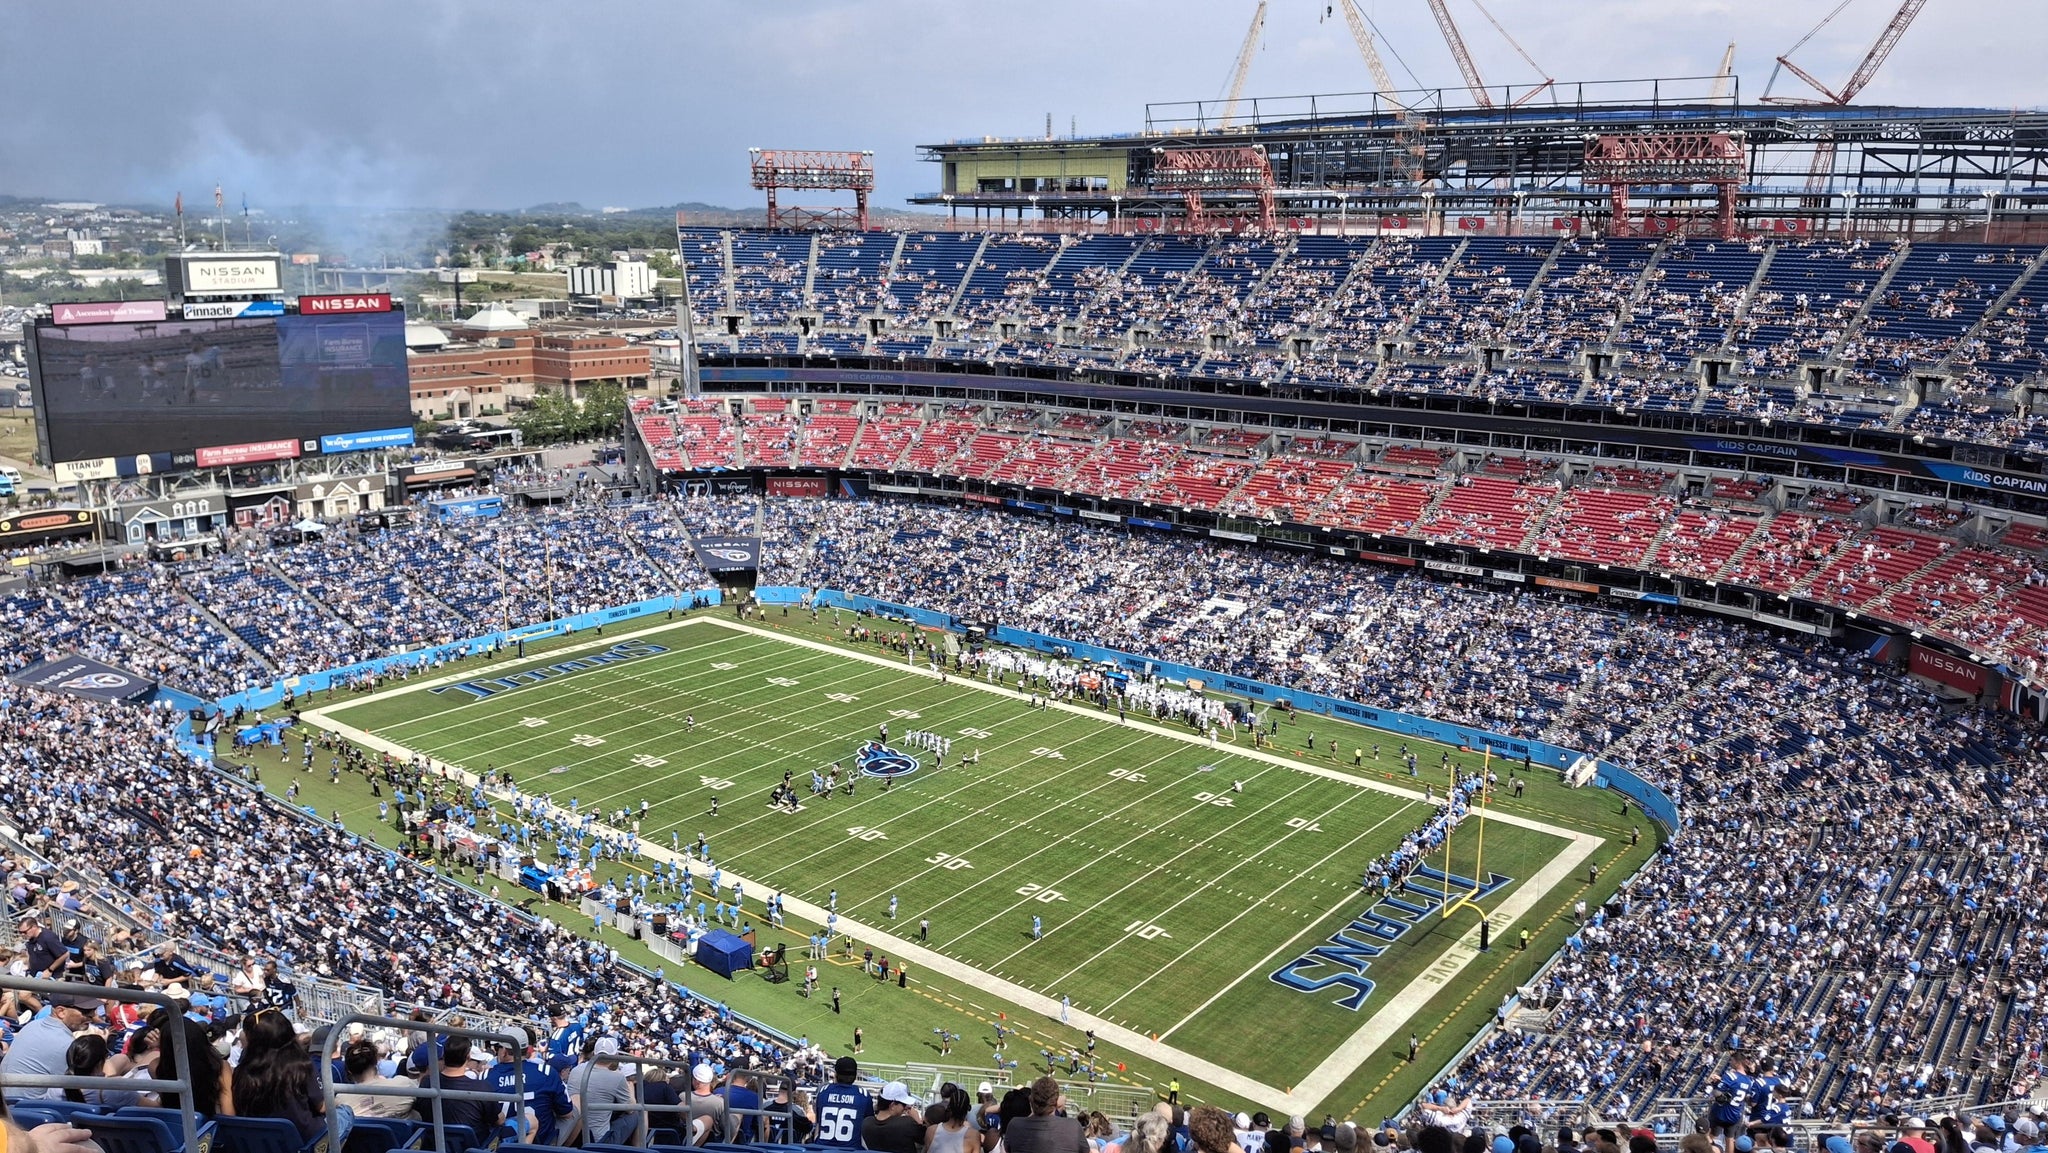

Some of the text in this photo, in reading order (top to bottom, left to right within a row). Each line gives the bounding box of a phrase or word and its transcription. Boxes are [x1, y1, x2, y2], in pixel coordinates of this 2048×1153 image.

[200, 266, 265, 276] NISSAN
[212, 277, 256, 285] STADIUM
[185, 305, 233, 318] Pinnacle
[312, 298, 380, 310] NISSAN
[76, 309, 109, 317] Ascension
[249, 441, 293, 453] INSURANCE
[1716, 439, 1798, 458] KIDS CAPTAIN
[66, 460, 104, 471] TITAN UP
[1963, 469, 2048, 493] KIDS CAPTAIN
[1611, 588, 1638, 598] Pinnacle
[427, 639, 671, 701] TITANS
[1919, 652, 1977, 681] NISSAN
[36, 664, 86, 686] NISSAN
[1334, 704, 1378, 721] TENNESSEE TOUGH
[957, 727, 993, 739] 50
[1030, 747, 1064, 759] 40
[1478, 736, 1529, 754] TENNESSEE TOUGH
[1107, 767, 1146, 782] 30
[1192, 791, 1233, 807] 20
[1285, 817, 1321, 832] 10
[846, 826, 883, 842] 40
[925, 852, 966, 870] 30
[1015, 883, 1061, 903] 20
[1123, 920, 1165, 940] 10
[1268, 859, 1515, 1012] TITANS
[1423, 953, 1467, 985] LOVE
[828, 1093, 855, 1105] NELSON
[819, 1106, 857, 1142] 56
